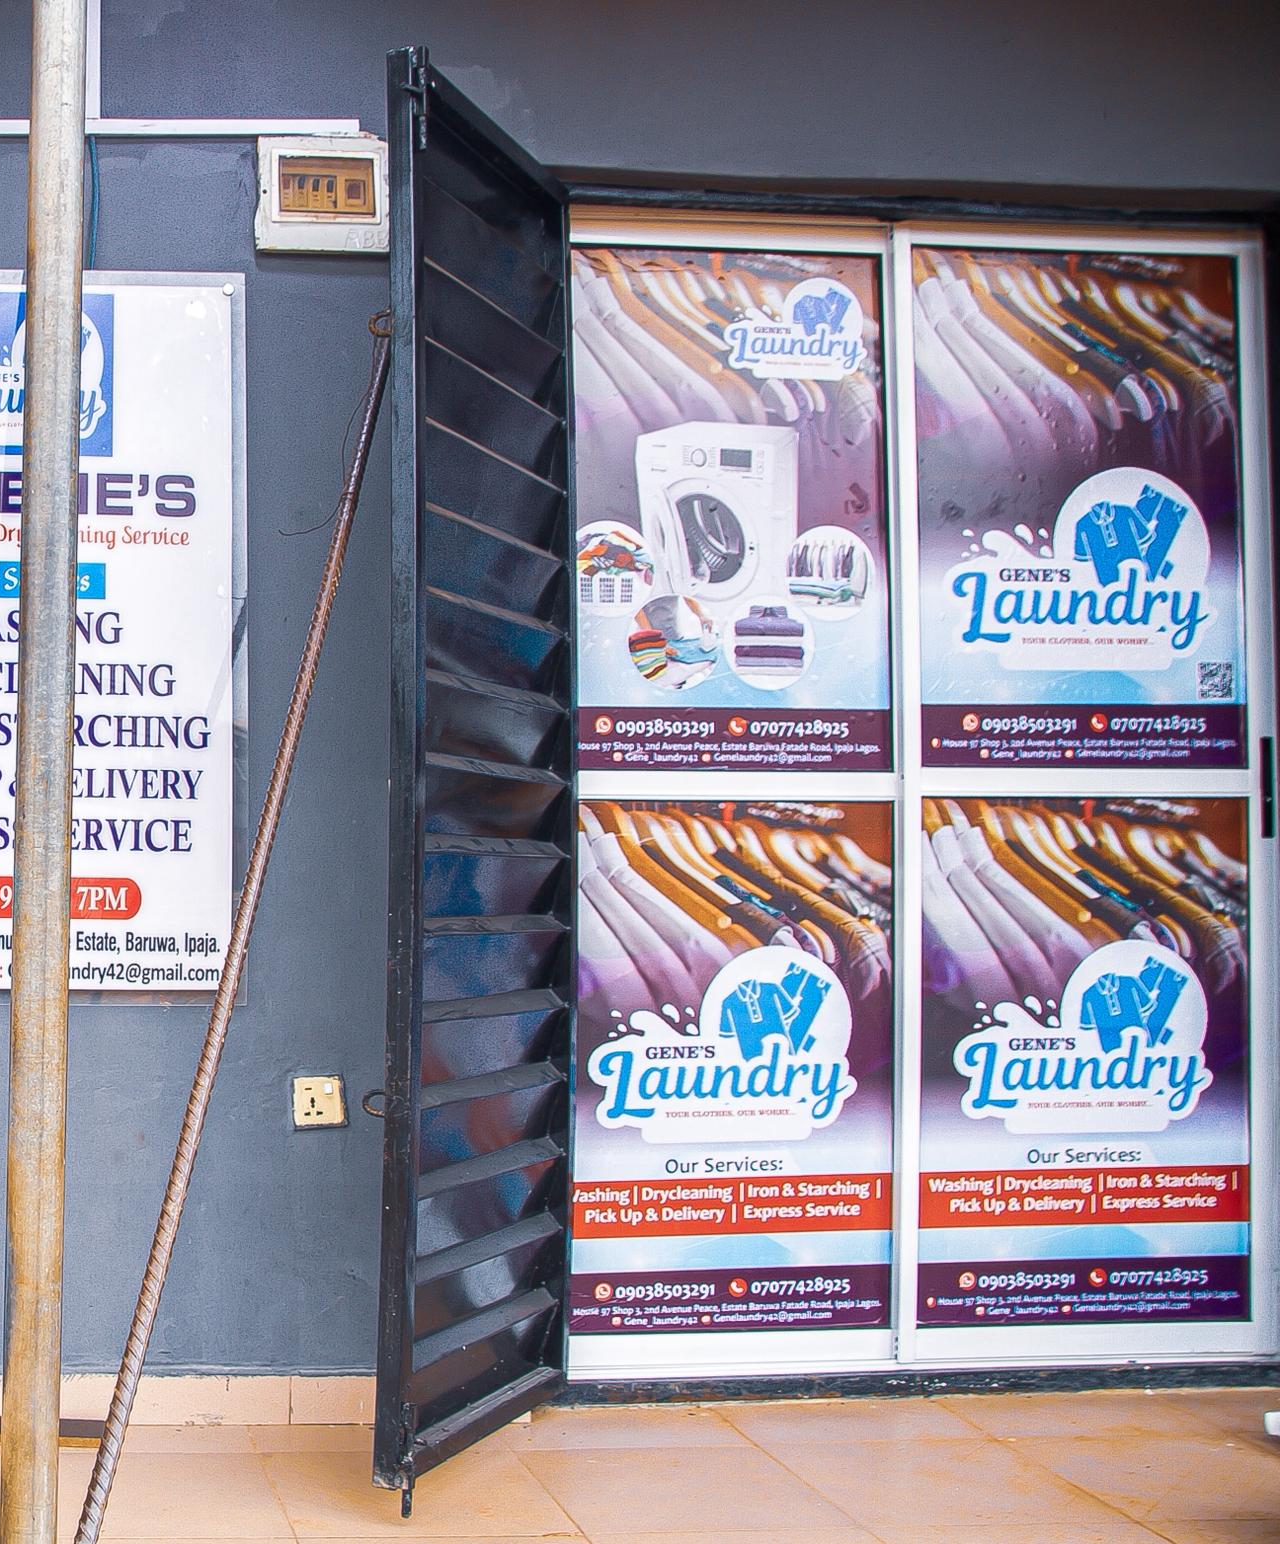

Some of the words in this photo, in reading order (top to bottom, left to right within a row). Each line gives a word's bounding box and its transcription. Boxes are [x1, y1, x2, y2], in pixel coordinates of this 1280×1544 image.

[730, 328, 862, 369] Laundry
[122, 526, 190, 546] Service
[999, 568, 1071, 582] GENE'S
[952, 568, 1209, 649] Laundry
[616, 720, 715, 738] 09038503291
[751, 720, 849, 738] 07077428925
[981, 716, 1076, 734] 09038503291
[1111, 716, 1207, 734] 07077428925
[72, 768, 203, 800] ELIVERY
[71, 818, 193, 852] ERVICE
[76, 886, 128, 911] 7PM
[77, 932, 120, 954] Estate,
[126, 932, 179, 955] Baruwa,
[185, 933, 220, 957] Ipaja.
[645, 1046, 715, 1059] GENE'S
[1009, 1037, 1076, 1051] GENE'S
[599, 1043, 848, 1119] Laundry
[965, 1035, 1205, 1111] Laundry
[665, 1159, 698, 1174] Our
[705, 1157, 783, 1173] Services:
[1027, 1149, 1058, 1164] Our
[1065, 1148, 1141, 1163] Services:
[641, 1184, 733, 1204] Drycleaning
[748, 1184, 779, 1198] Iron
[782, 1183, 795, 1197] &
[798, 1180, 870, 1199] Starching
[928, 1177, 994, 1195] Washing
[1004, 1176, 1093, 1194] Drycleaning
[1106, 1174, 1137, 1188] Iron
[1139, 1175, 1152, 1188] &
[1155, 1173, 1226, 1191] Starching
[585, 1208, 616, 1223] Pick
[620, 1208, 642, 1225] Up
[645, 1208, 659, 1222] &
[662, 1205, 725, 1223] Delivery
[744, 1204, 802, 1221] Express
[805, 1202, 860, 1217] Service
[950, 1198, 981, 1213] Pick
[984, 1198, 1006, 1215] Up
[1008, 1198, 1021, 1212] &
[1023, 1196, 1085, 1213] Delivery
[1103, 1195, 1159, 1212] Express
[1162, 1194, 1217, 1208] Service
[615, 1283, 715, 1302] 09038503291
[751, 1277, 850, 1295] 07077428925
[979, 1273, 1075, 1291] 09038503291
[1110, 1268, 1208, 1286] 07077428925
